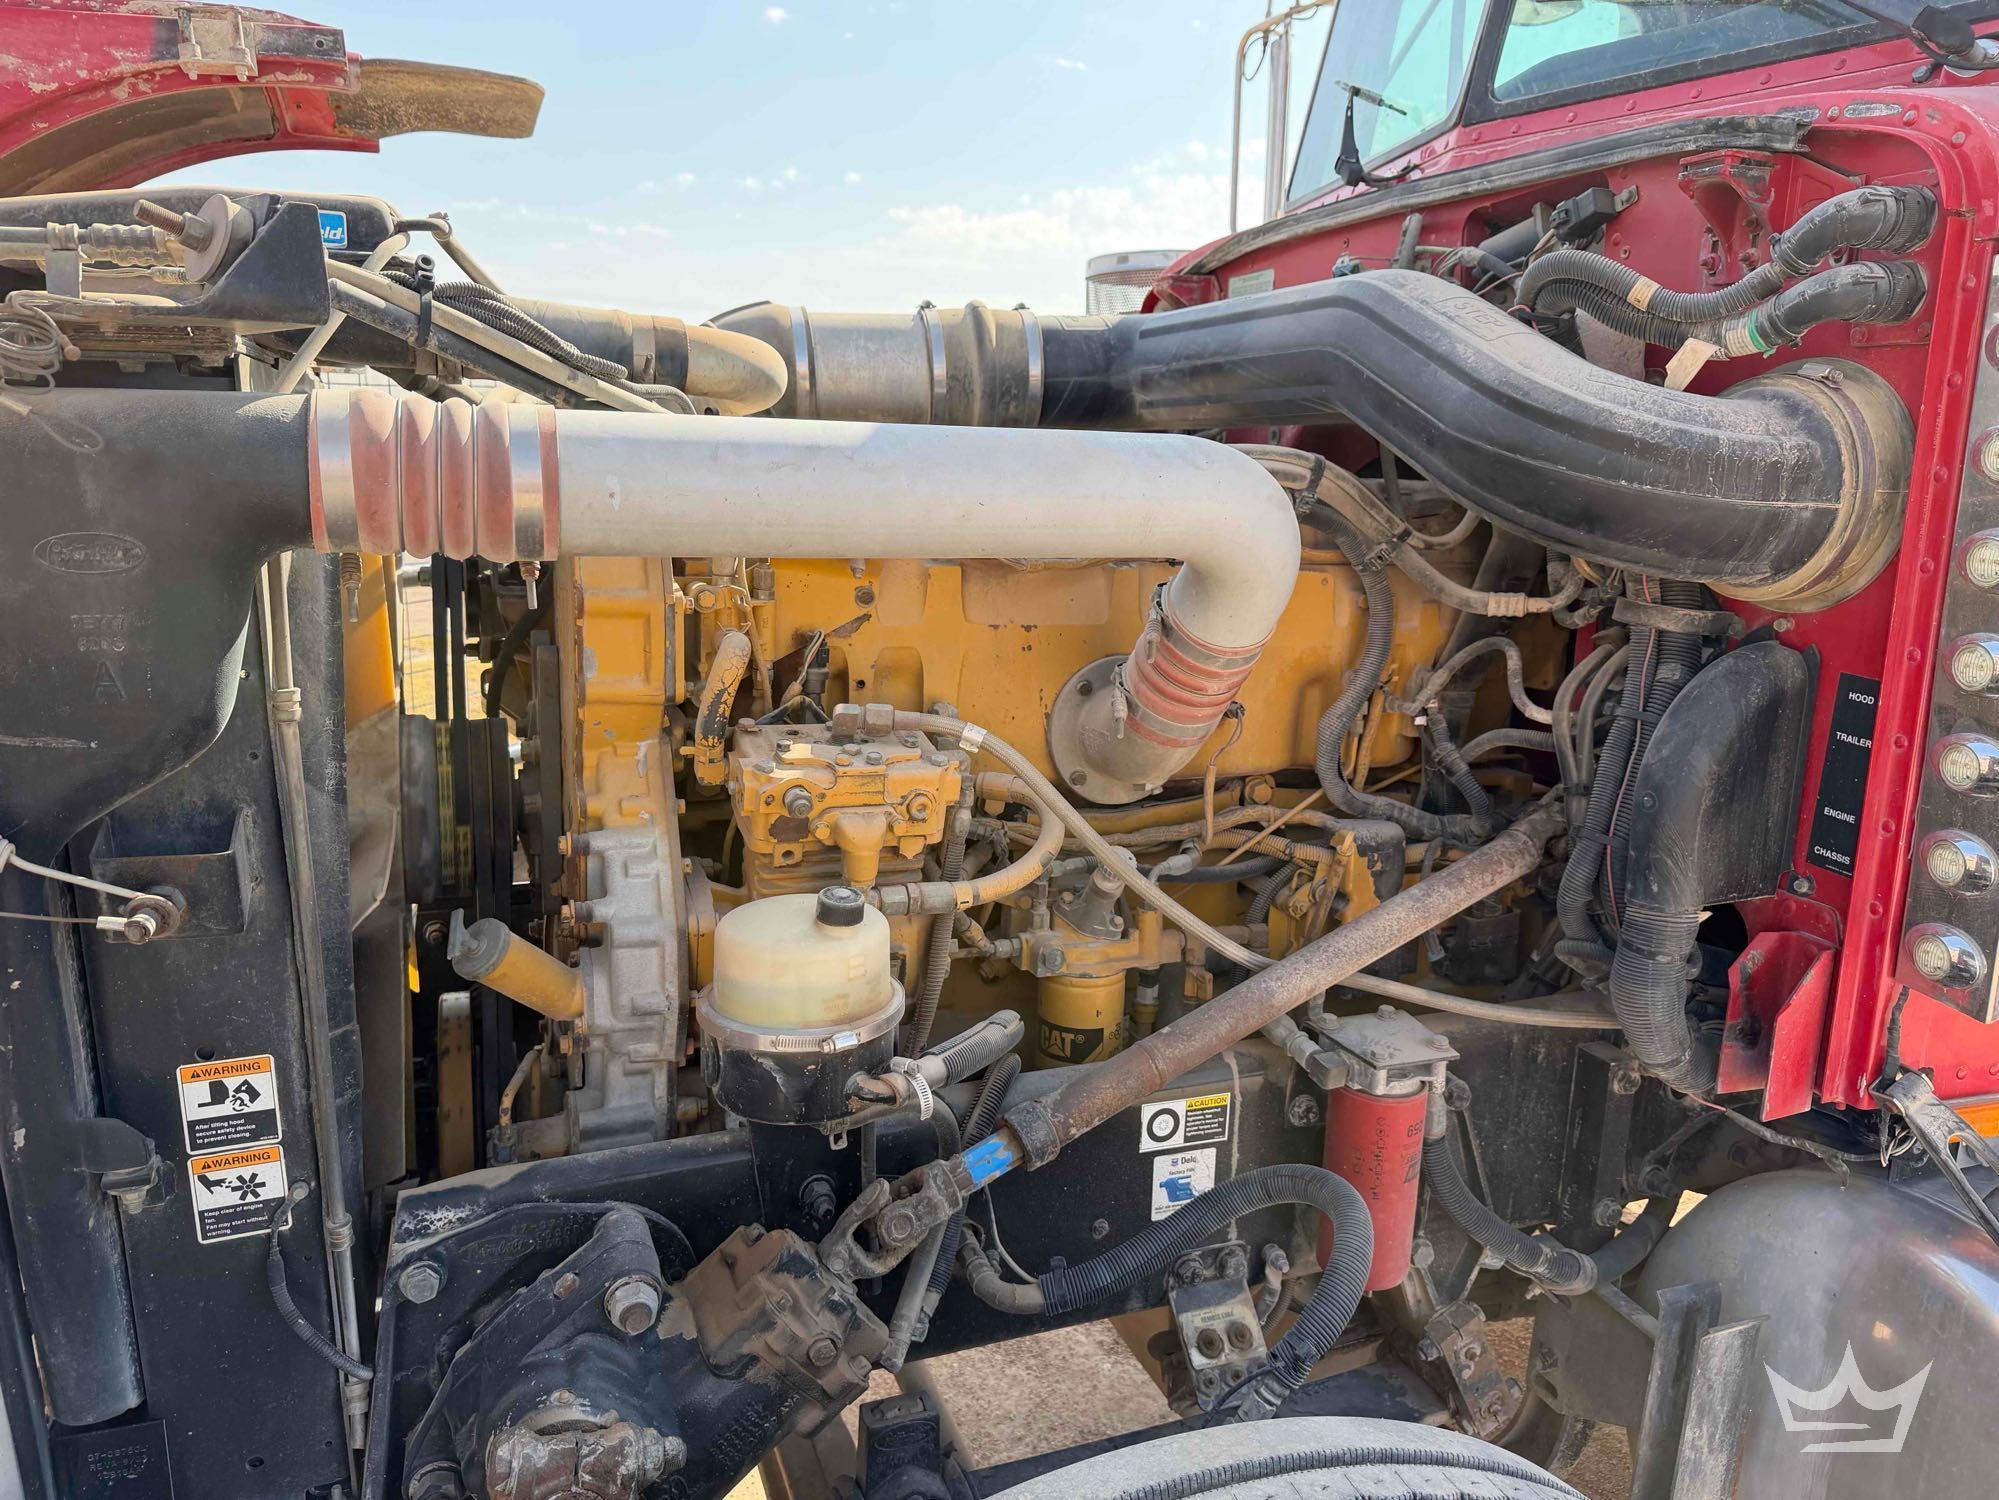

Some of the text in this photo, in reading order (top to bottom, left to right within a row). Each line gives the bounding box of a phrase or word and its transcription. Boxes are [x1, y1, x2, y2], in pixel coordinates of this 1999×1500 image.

[1848, 691, 1875, 705] HOOD
[1836, 731, 1872, 749] TRAILER
[1823, 806, 1856, 824] ENGINE
[1814, 845, 1851, 865] CHASSIS
[1041, 1023, 1074, 1058] CAT
[200, 1061, 261, 1078] WARNING
[1194, 1096, 1227, 1108] CAUTION
[229, 1118, 245, 1126] hood
[204, 1135, 227, 1144] prevent
[211, 1151, 271, 1169] WARNING
[243, 1203, 263, 1211] engine
[218, 1221, 231, 1229] may
[246, 1215, 269, 1223] without
